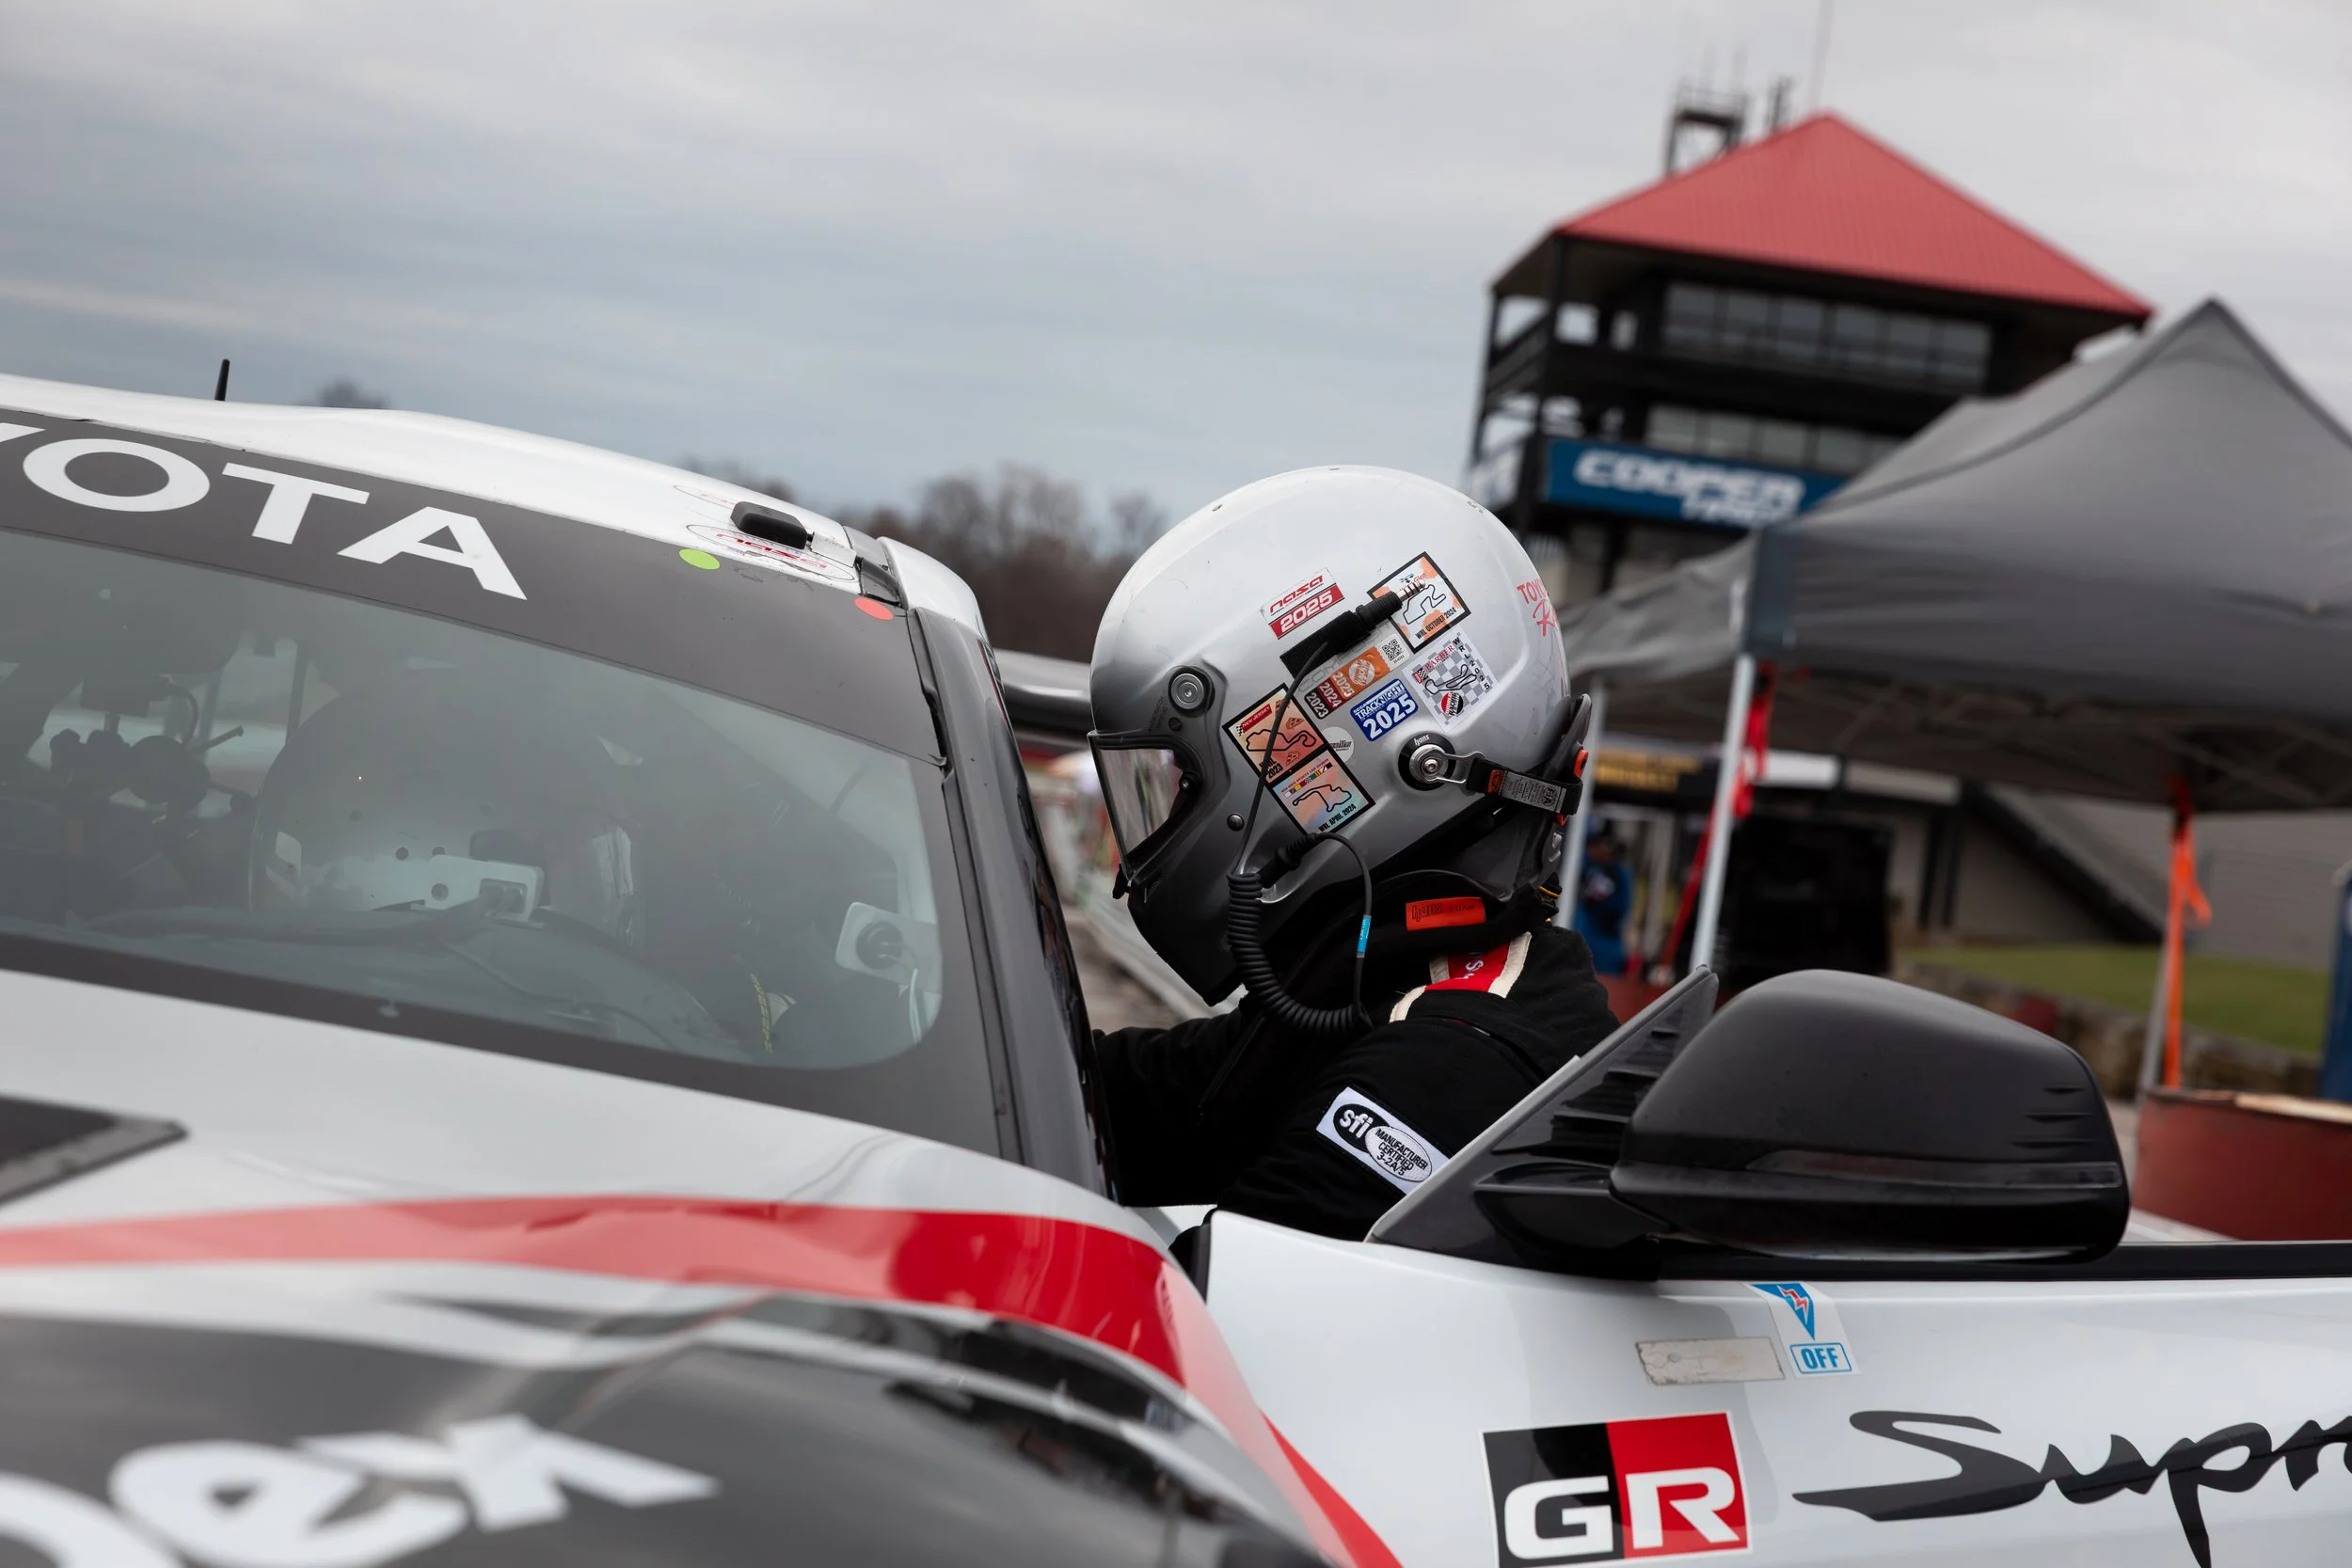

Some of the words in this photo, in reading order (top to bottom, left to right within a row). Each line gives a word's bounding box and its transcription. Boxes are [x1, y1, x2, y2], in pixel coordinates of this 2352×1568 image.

[0, 422, 527, 600] OTA
[1270, 575, 1323, 613] nasa
[1280, 590, 1333, 633] 2025
[1425, 614, 1445, 631] OCTOBER
[1444, 607, 1457, 619] 2024
[1424, 645, 1454, 671] BARBER
[1319, 682, 1343, 708] 2024
[1332, 672, 1355, 697] 2025
[1306, 692, 1329, 718] 2023
[1362, 693, 1416, 738] 2025
[1413, 734, 1430, 746] hans
[1267, 763, 1283, 780] 2023
[1328, 814, 1344, 827] APRIL
[1342, 803, 1357, 816] 2024
[1375, 1129, 1429, 1170] MANUFACTURER
[1378, 1141, 1415, 1171] CERTIFIED
[1376, 1151, 1406, 1176] 3-2A/5
[1801, 1347, 1839, 1370] OFF
[0, 1414, 718, 1568] ex
[1504, 1467, 1740, 1560] GR
